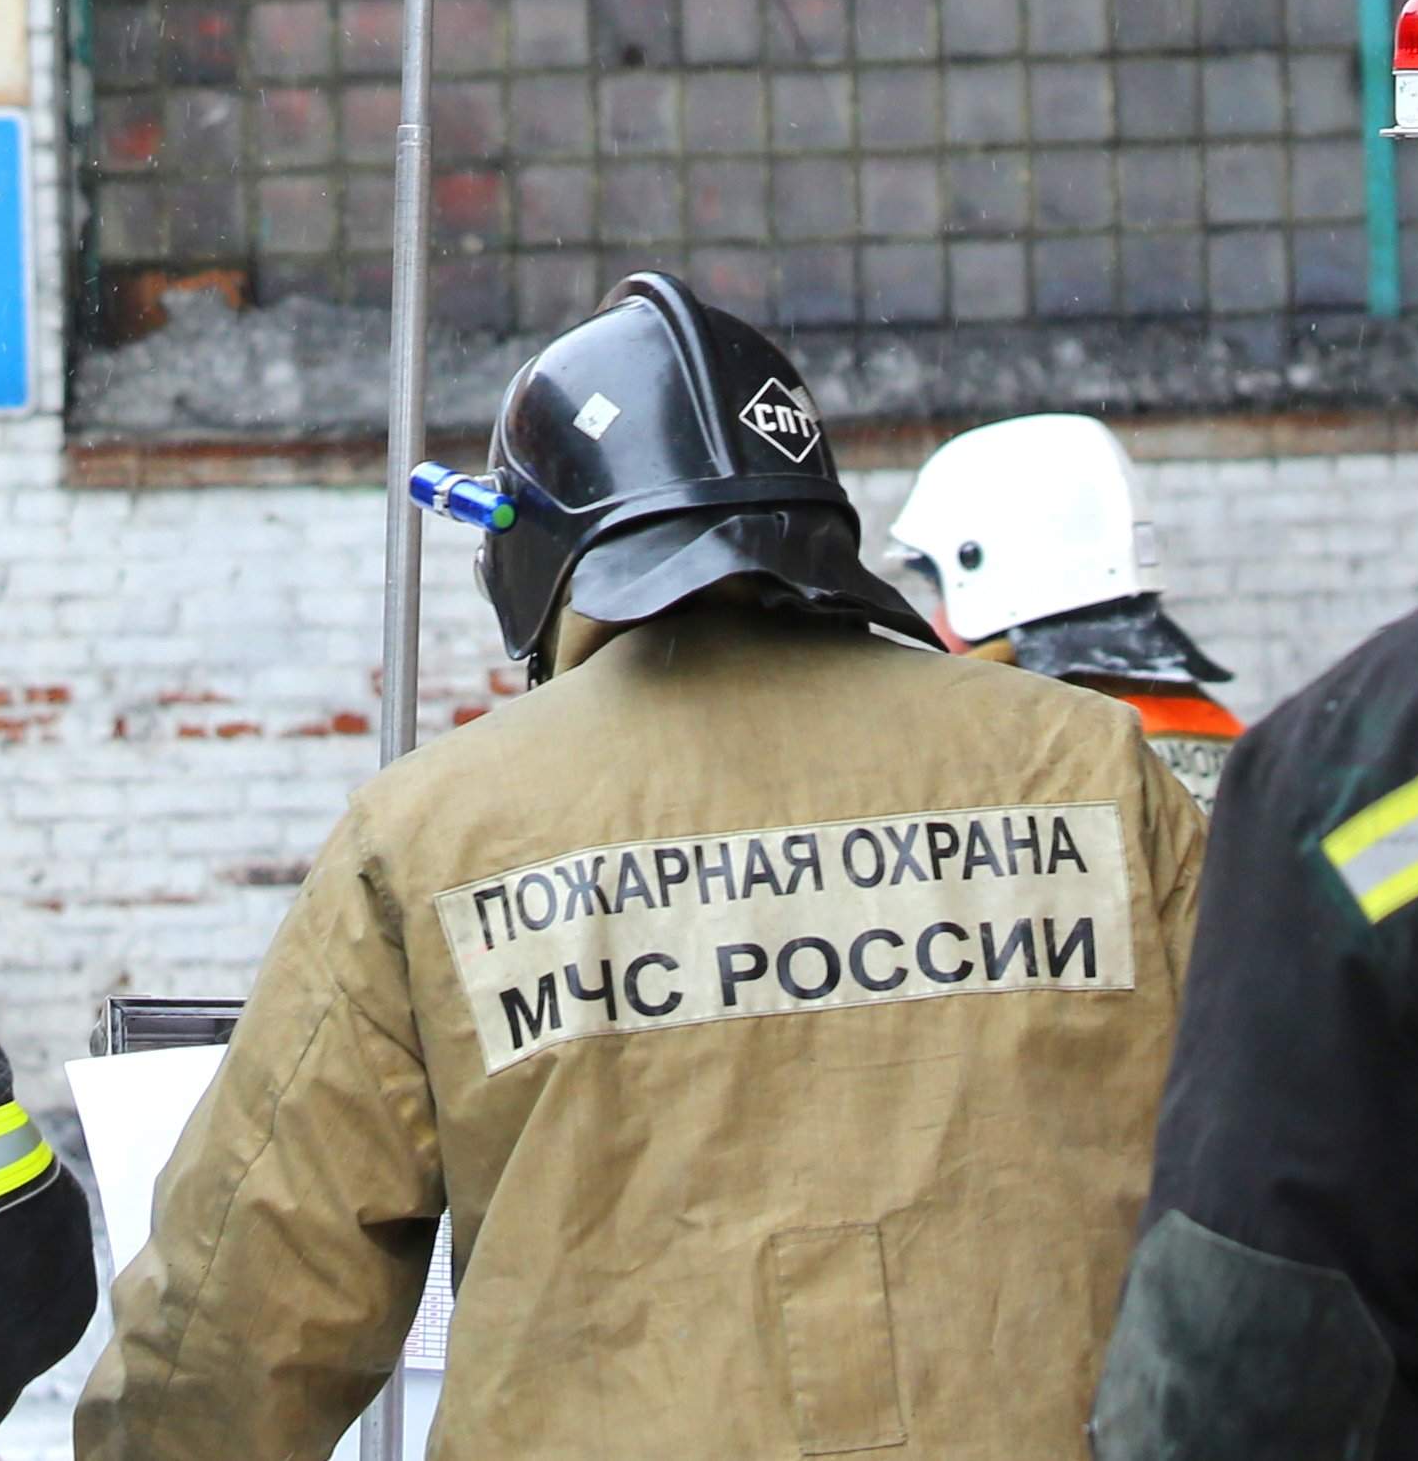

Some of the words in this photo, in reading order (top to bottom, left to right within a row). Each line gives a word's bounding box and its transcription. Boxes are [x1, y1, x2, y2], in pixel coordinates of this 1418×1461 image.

[754, 403, 813, 438] СПТ
[472, 833, 825, 951] ПОЖАРНАЯ
[840, 815, 1088, 890] ОХРАНА
[499, 953, 683, 1050] МЧС
[715, 917, 1098, 1007] РОССИИ
